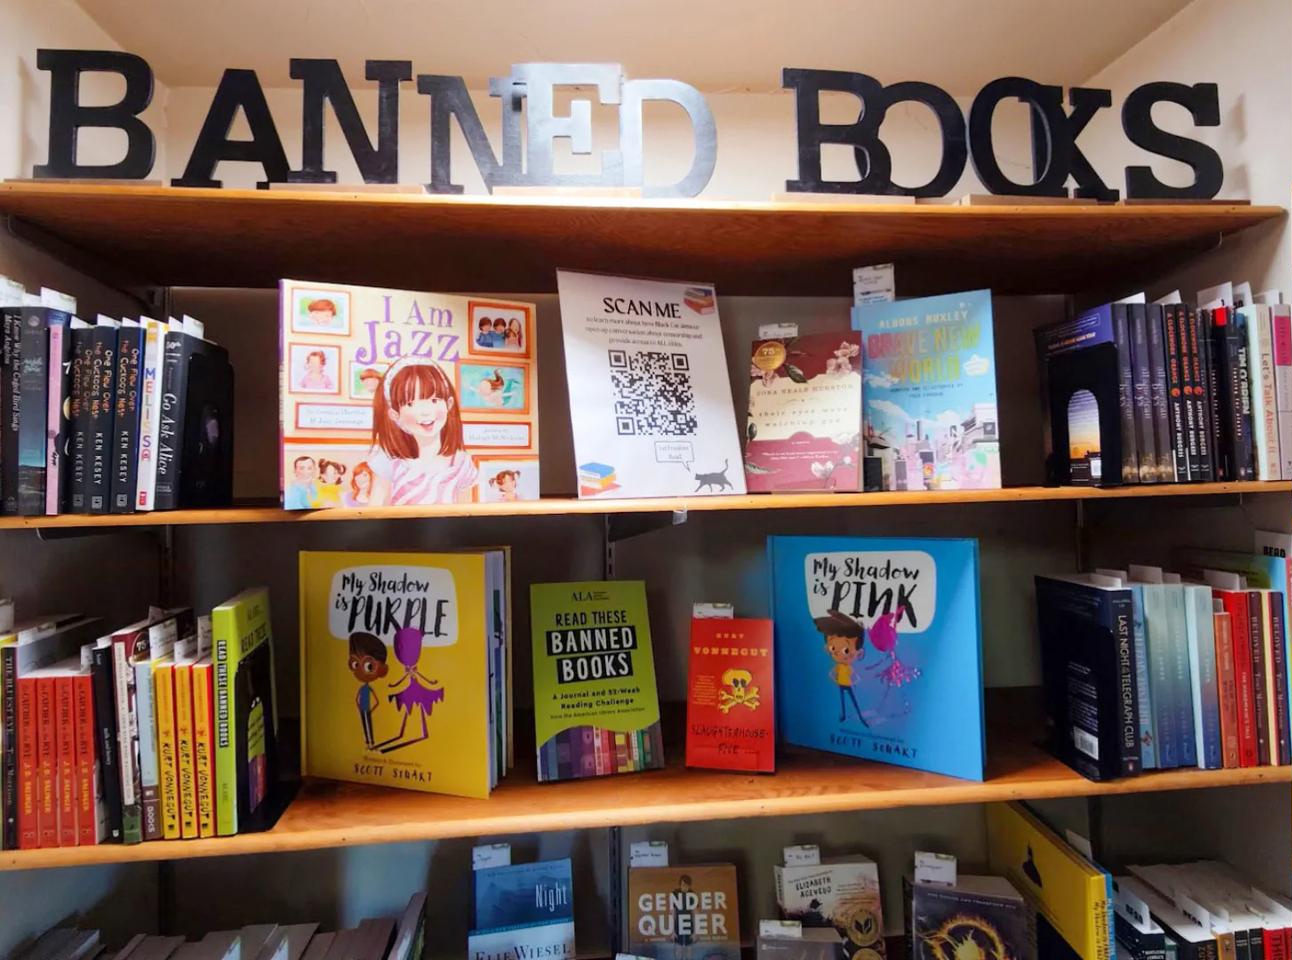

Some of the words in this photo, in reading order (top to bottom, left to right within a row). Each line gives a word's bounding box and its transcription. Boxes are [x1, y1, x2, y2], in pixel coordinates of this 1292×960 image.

[33, 49, 717, 198] BANNED
[783, 68, 1224, 202] BOOKS
[382, 295, 392, 324] I
[404, 299, 453, 328] Am
[603, 297, 652, 317] SCAN
[655, 302, 681, 319] ME
[355, 320, 460, 365] Jazz
[1238, 346, 1247, 367] TIM
[1261, 352, 1271, 380] Let's
[162, 392, 177, 411] Go
[1264, 382, 1273, 406] Talk
[159, 415, 176, 439] Ask
[95, 432, 103, 451] KEN
[120, 430, 128, 449] KEN
[94, 455, 103, 485] KESEY
[119, 453, 127, 483] KESEY
[158, 442, 174, 475] Alice
[1263, 546, 1286, 558] READ
[813, 557, 841, 581] My
[844, 557, 920, 580] Shadow
[342, 573, 364, 596] My
[369, 571, 430, 593] Shadow
[571, 591, 593, 601] ALA
[813, 578, 828, 596] is
[831, 580, 918, 628] PINK
[335, 593, 349, 611] is
[348, 594, 450, 638] PURPLE
[555, 611, 587, 627] READ
[592, 610, 627, 624] THESE
[1118, 615, 1129, 636] LAST
[217, 640, 227, 661] READ
[551, 627, 634, 654] BANNED
[694, 646, 769, 657] VONNEGUT
[1120, 638, 1130, 666] NIGHT
[218, 664, 228, 687] THESE
[562, 653, 630, 682] BOOKS
[218, 690, 228, 720] BANNED
[561, 689, 588, 700] Journal
[592, 688, 605, 697] and
[561, 701, 593, 710] Reading
[596, 697, 634, 707] Challenge
[1121, 674, 1132, 724] TELEGRAPH
[219, 723, 230, 747] BOOKS
[1124, 725, 1135, 748] CLUB
[163, 741, 173, 768] KURT
[180, 739, 191, 765] KURT
[197, 741, 208, 767] KURT
[164, 771, 176, 822] VONNEGUT
[181, 767, 193, 818] VONNEGUT
[199, 769, 210, 820] VONNEGUT
[796, 876, 831, 891] ELIZABETH
[800, 886, 832, 898] ACEVEDO
[535, 883, 568, 912] Night
[638, 892, 728, 912] GENDER
[638, 913, 728, 936] QUEER
[514, 943, 572, 960] WIESEL
